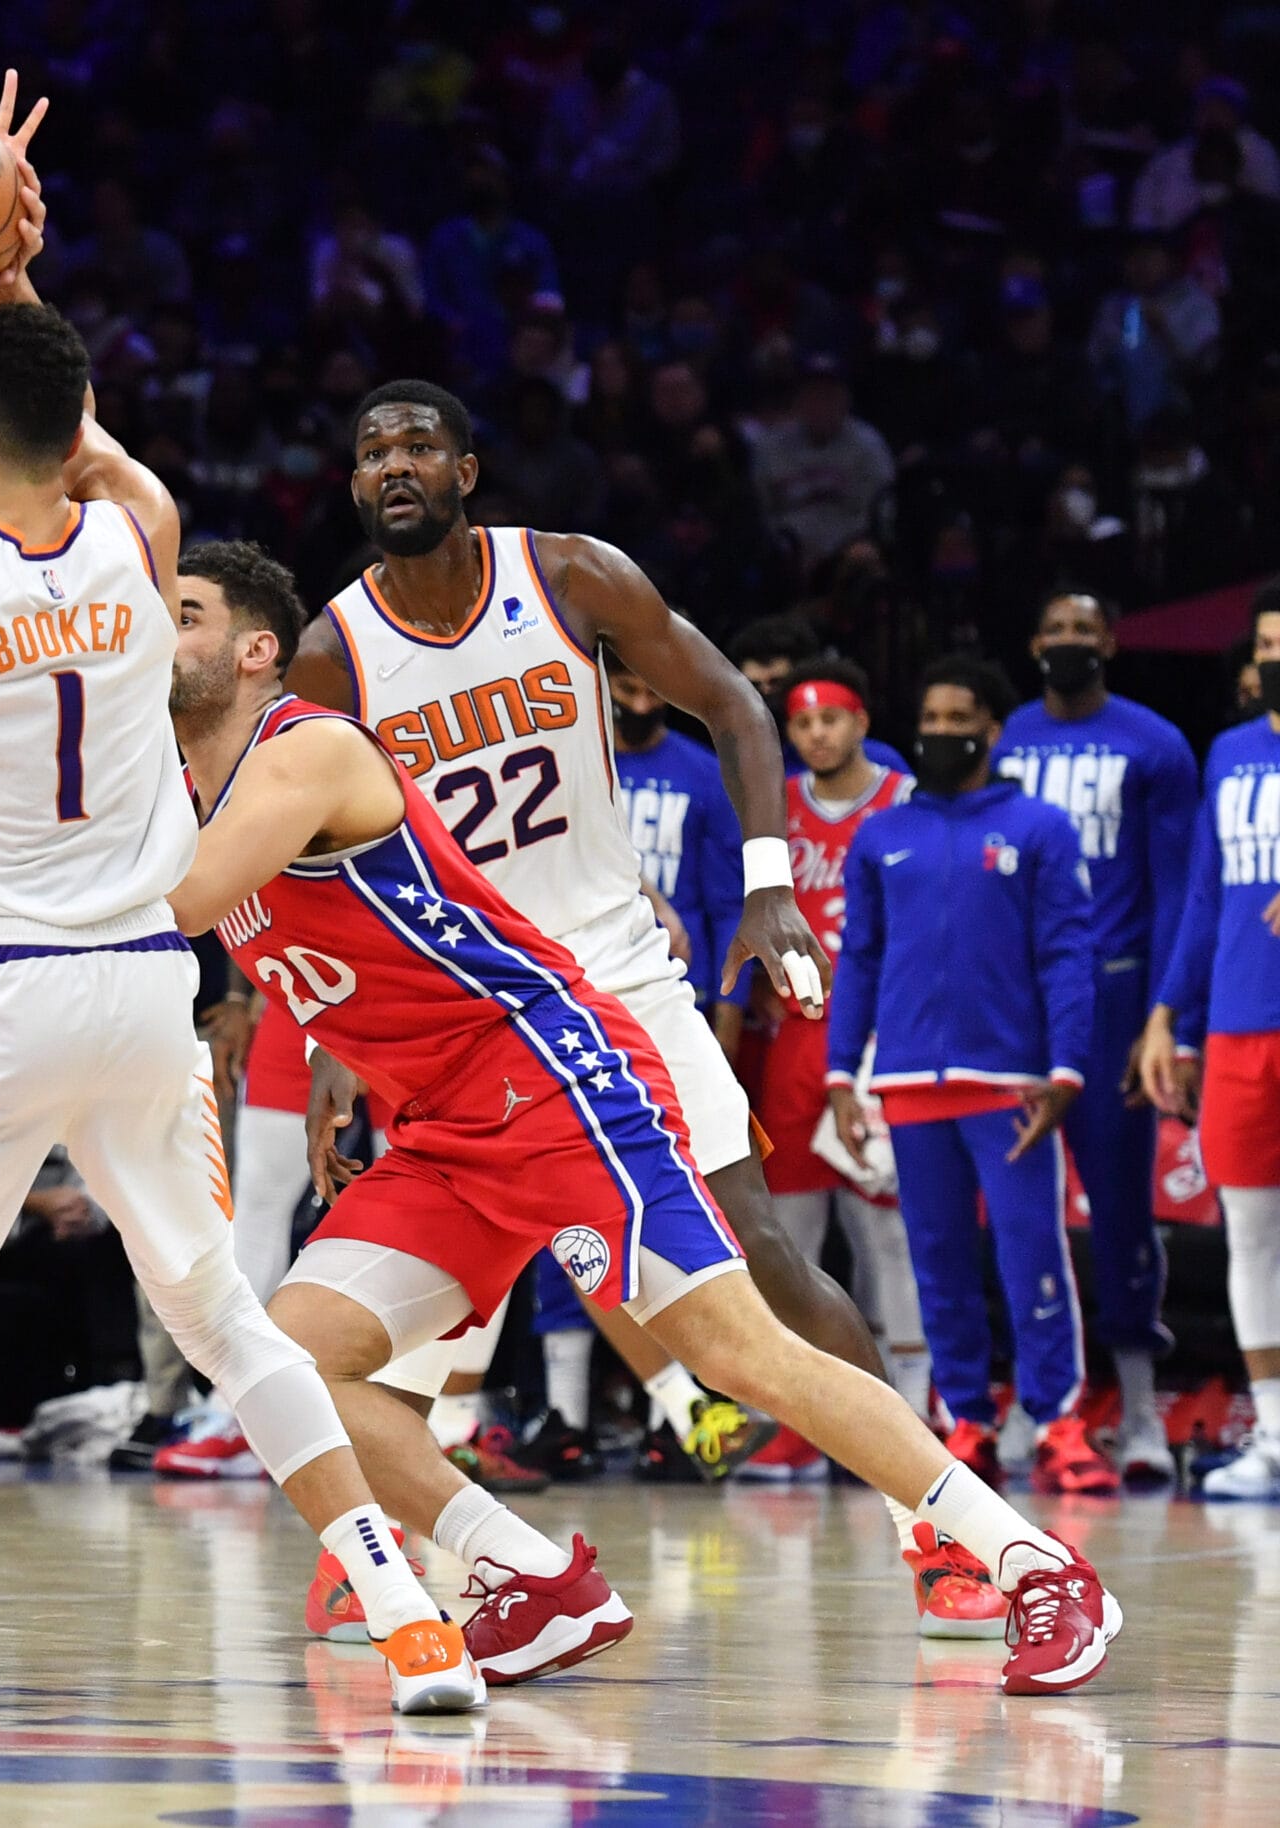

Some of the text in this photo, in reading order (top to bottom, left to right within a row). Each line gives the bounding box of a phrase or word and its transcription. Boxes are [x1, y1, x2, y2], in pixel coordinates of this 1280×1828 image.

[503, 615, 539, 640] PayPal
[49, 669, 91, 824] 1
[376, 660, 579, 779] SUNS
[433, 745, 569, 866] 22
[255, 945, 357, 1026] 20
[563, 1253, 605, 1278] 6ers
